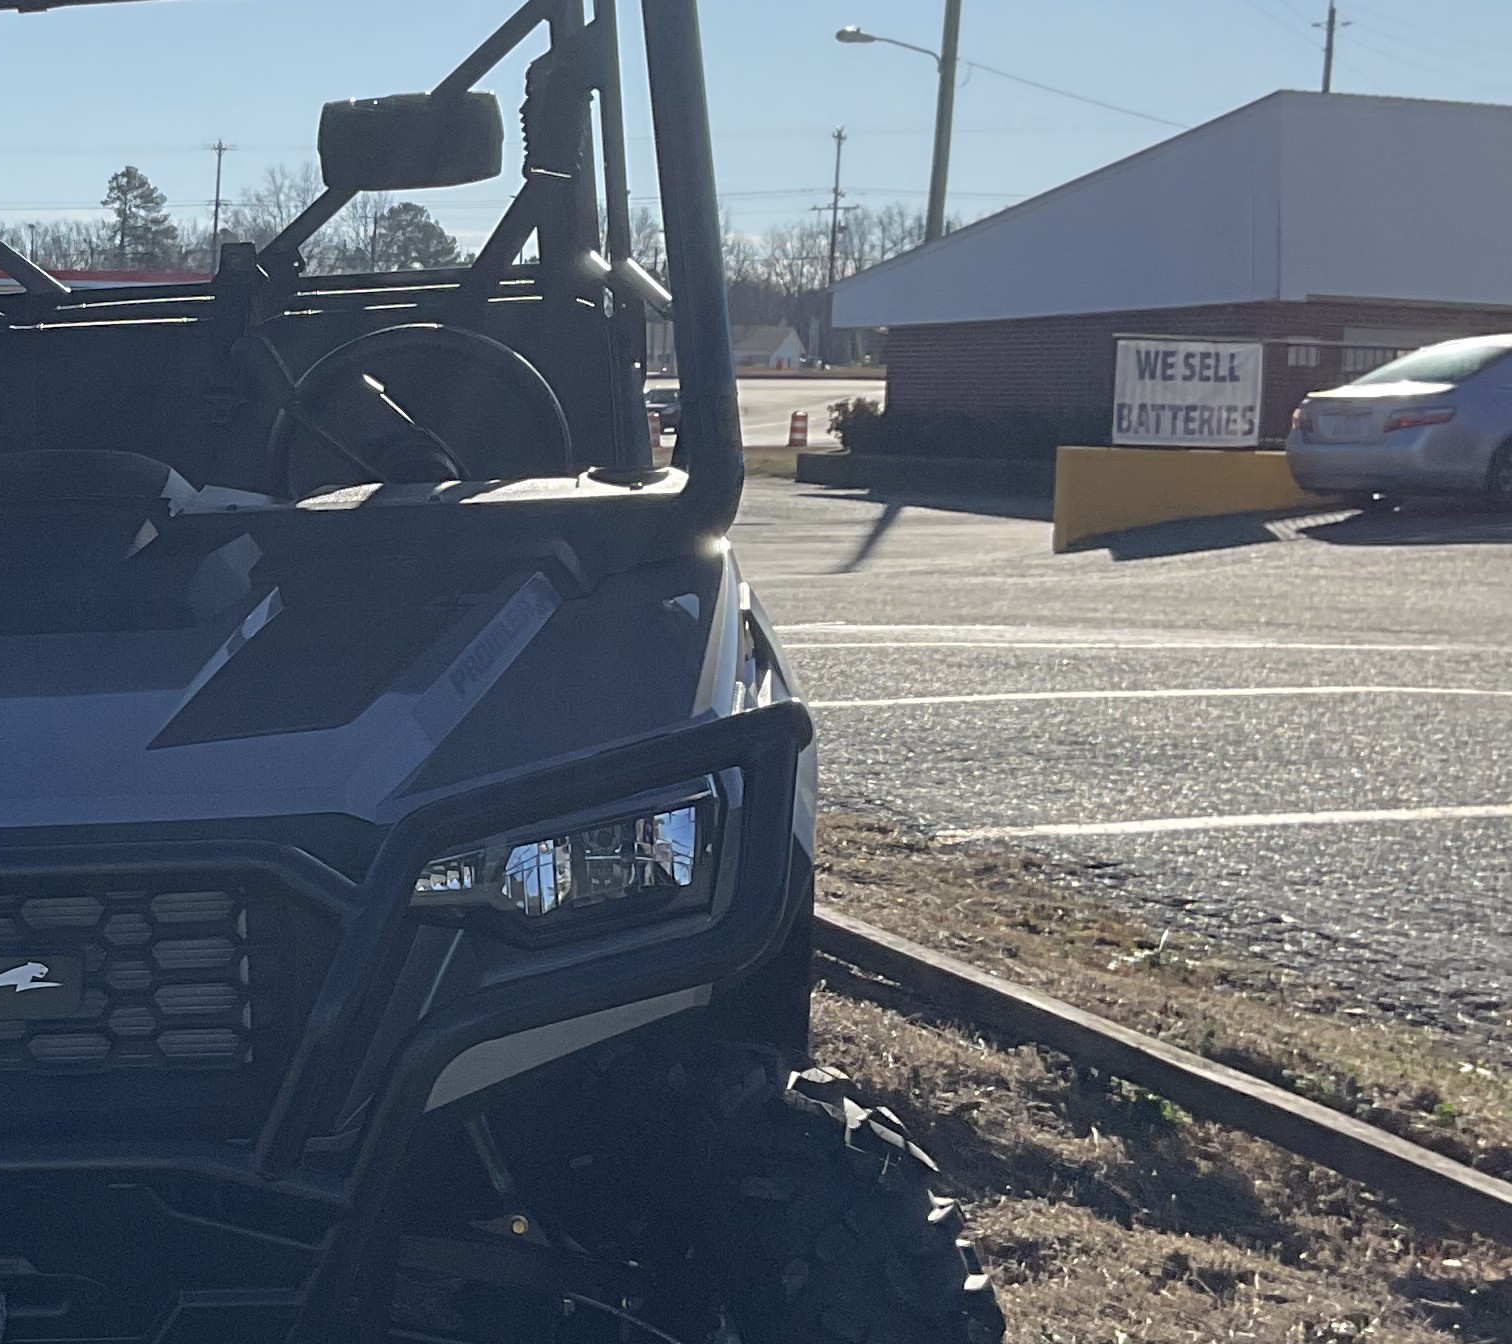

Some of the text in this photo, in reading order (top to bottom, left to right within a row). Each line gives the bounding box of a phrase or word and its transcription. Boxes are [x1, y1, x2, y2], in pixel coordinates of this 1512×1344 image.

[1136, 349, 1241, 383] WE SELL
[1116, 401, 1256, 437] BATTERIES
